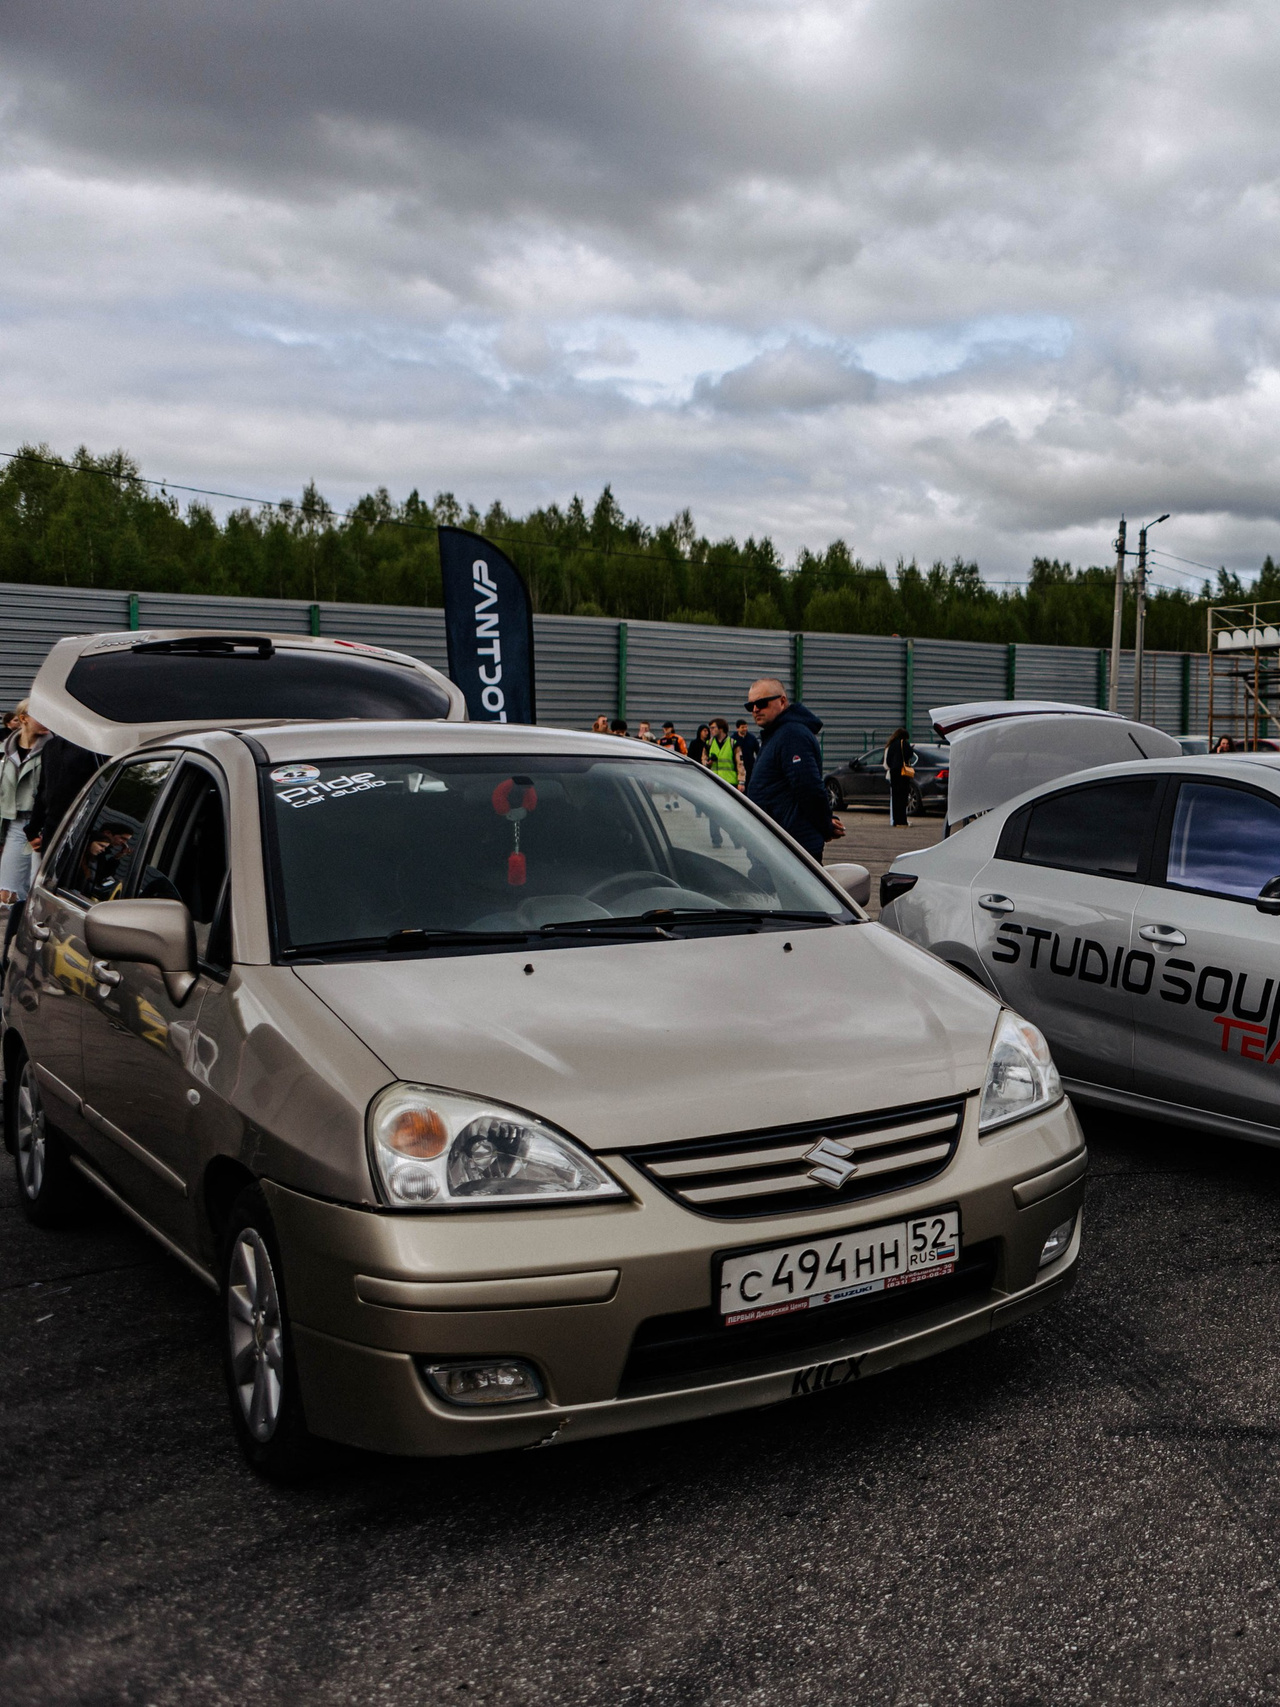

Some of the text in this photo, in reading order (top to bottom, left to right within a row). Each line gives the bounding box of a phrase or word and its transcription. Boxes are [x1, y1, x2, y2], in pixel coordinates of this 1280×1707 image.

[276, 772, 376, 803] Pride
[331, 780, 387, 798] audio
[992, 922, 1156, 995] STUDIO
[739, 1218, 947, 1302] С494НН 52
[910, 1250, 936, 1266] RUS
[833, 1285, 873, 1300] SUZUKI
[728, 1312, 755, 1324] ПЕРВЫЙ
[790, 1301, 808, 1312] Центр
[791, 1353, 869, 1396] KICX
